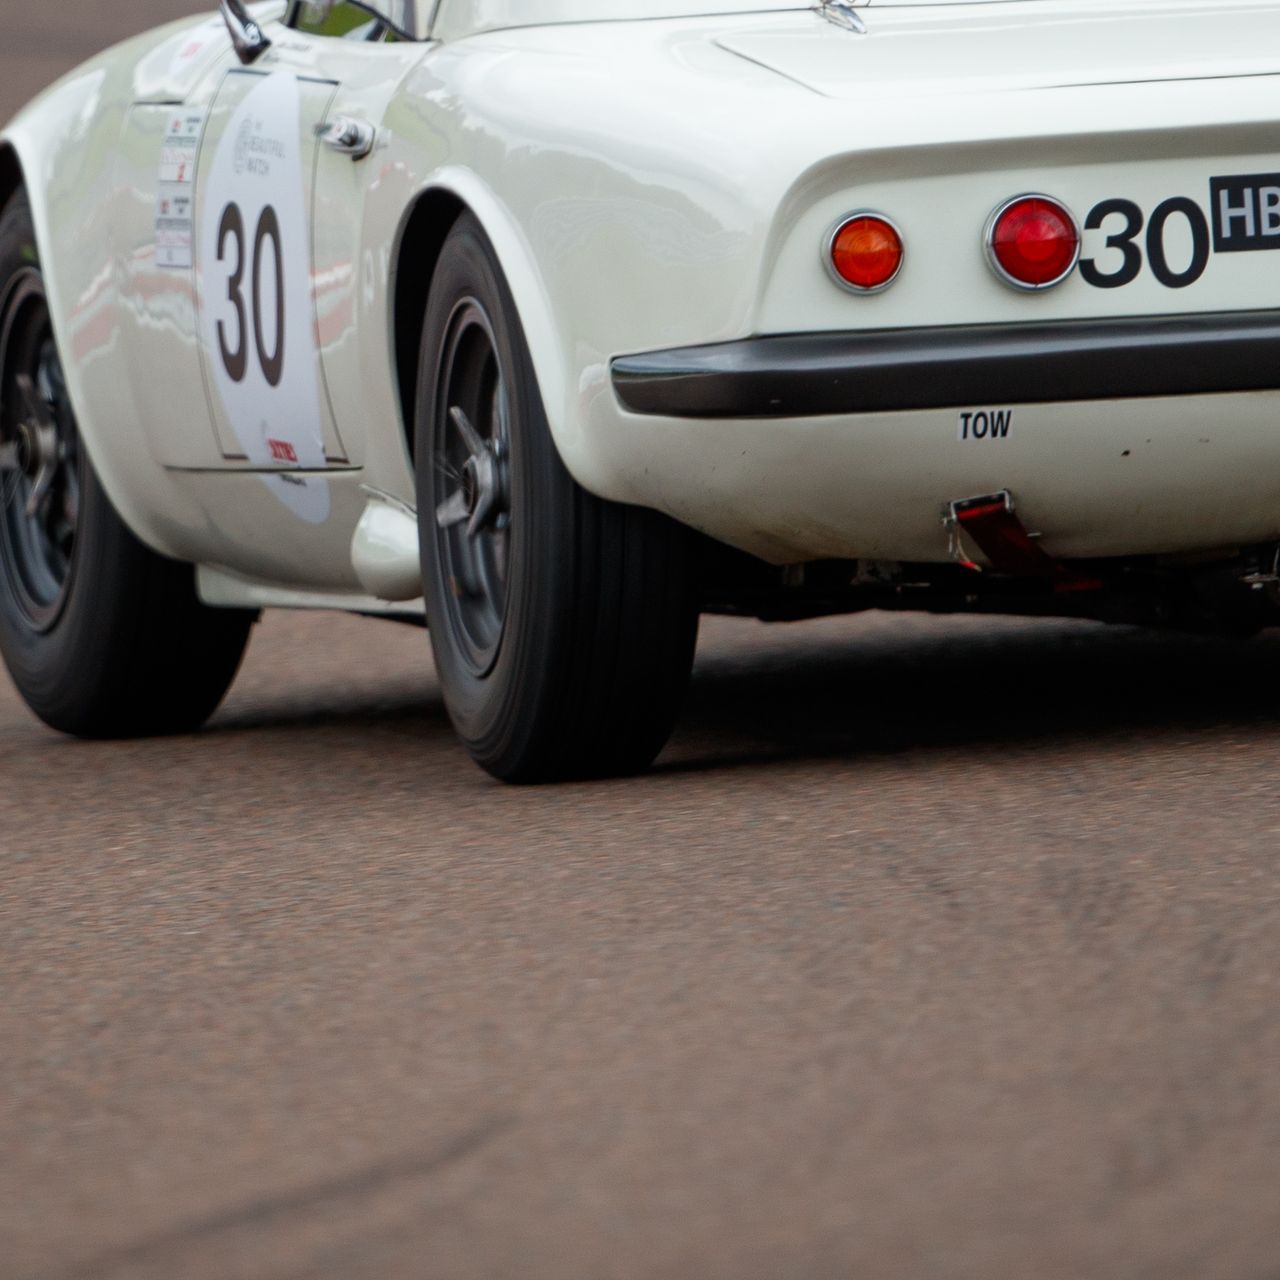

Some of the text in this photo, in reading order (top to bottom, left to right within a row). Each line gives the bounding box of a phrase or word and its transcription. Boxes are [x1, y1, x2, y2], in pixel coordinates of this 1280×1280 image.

[1078, 196, 1210, 289] 30
[217, 201, 286, 388] 30
[960, 410, 1012, 440] TOW
